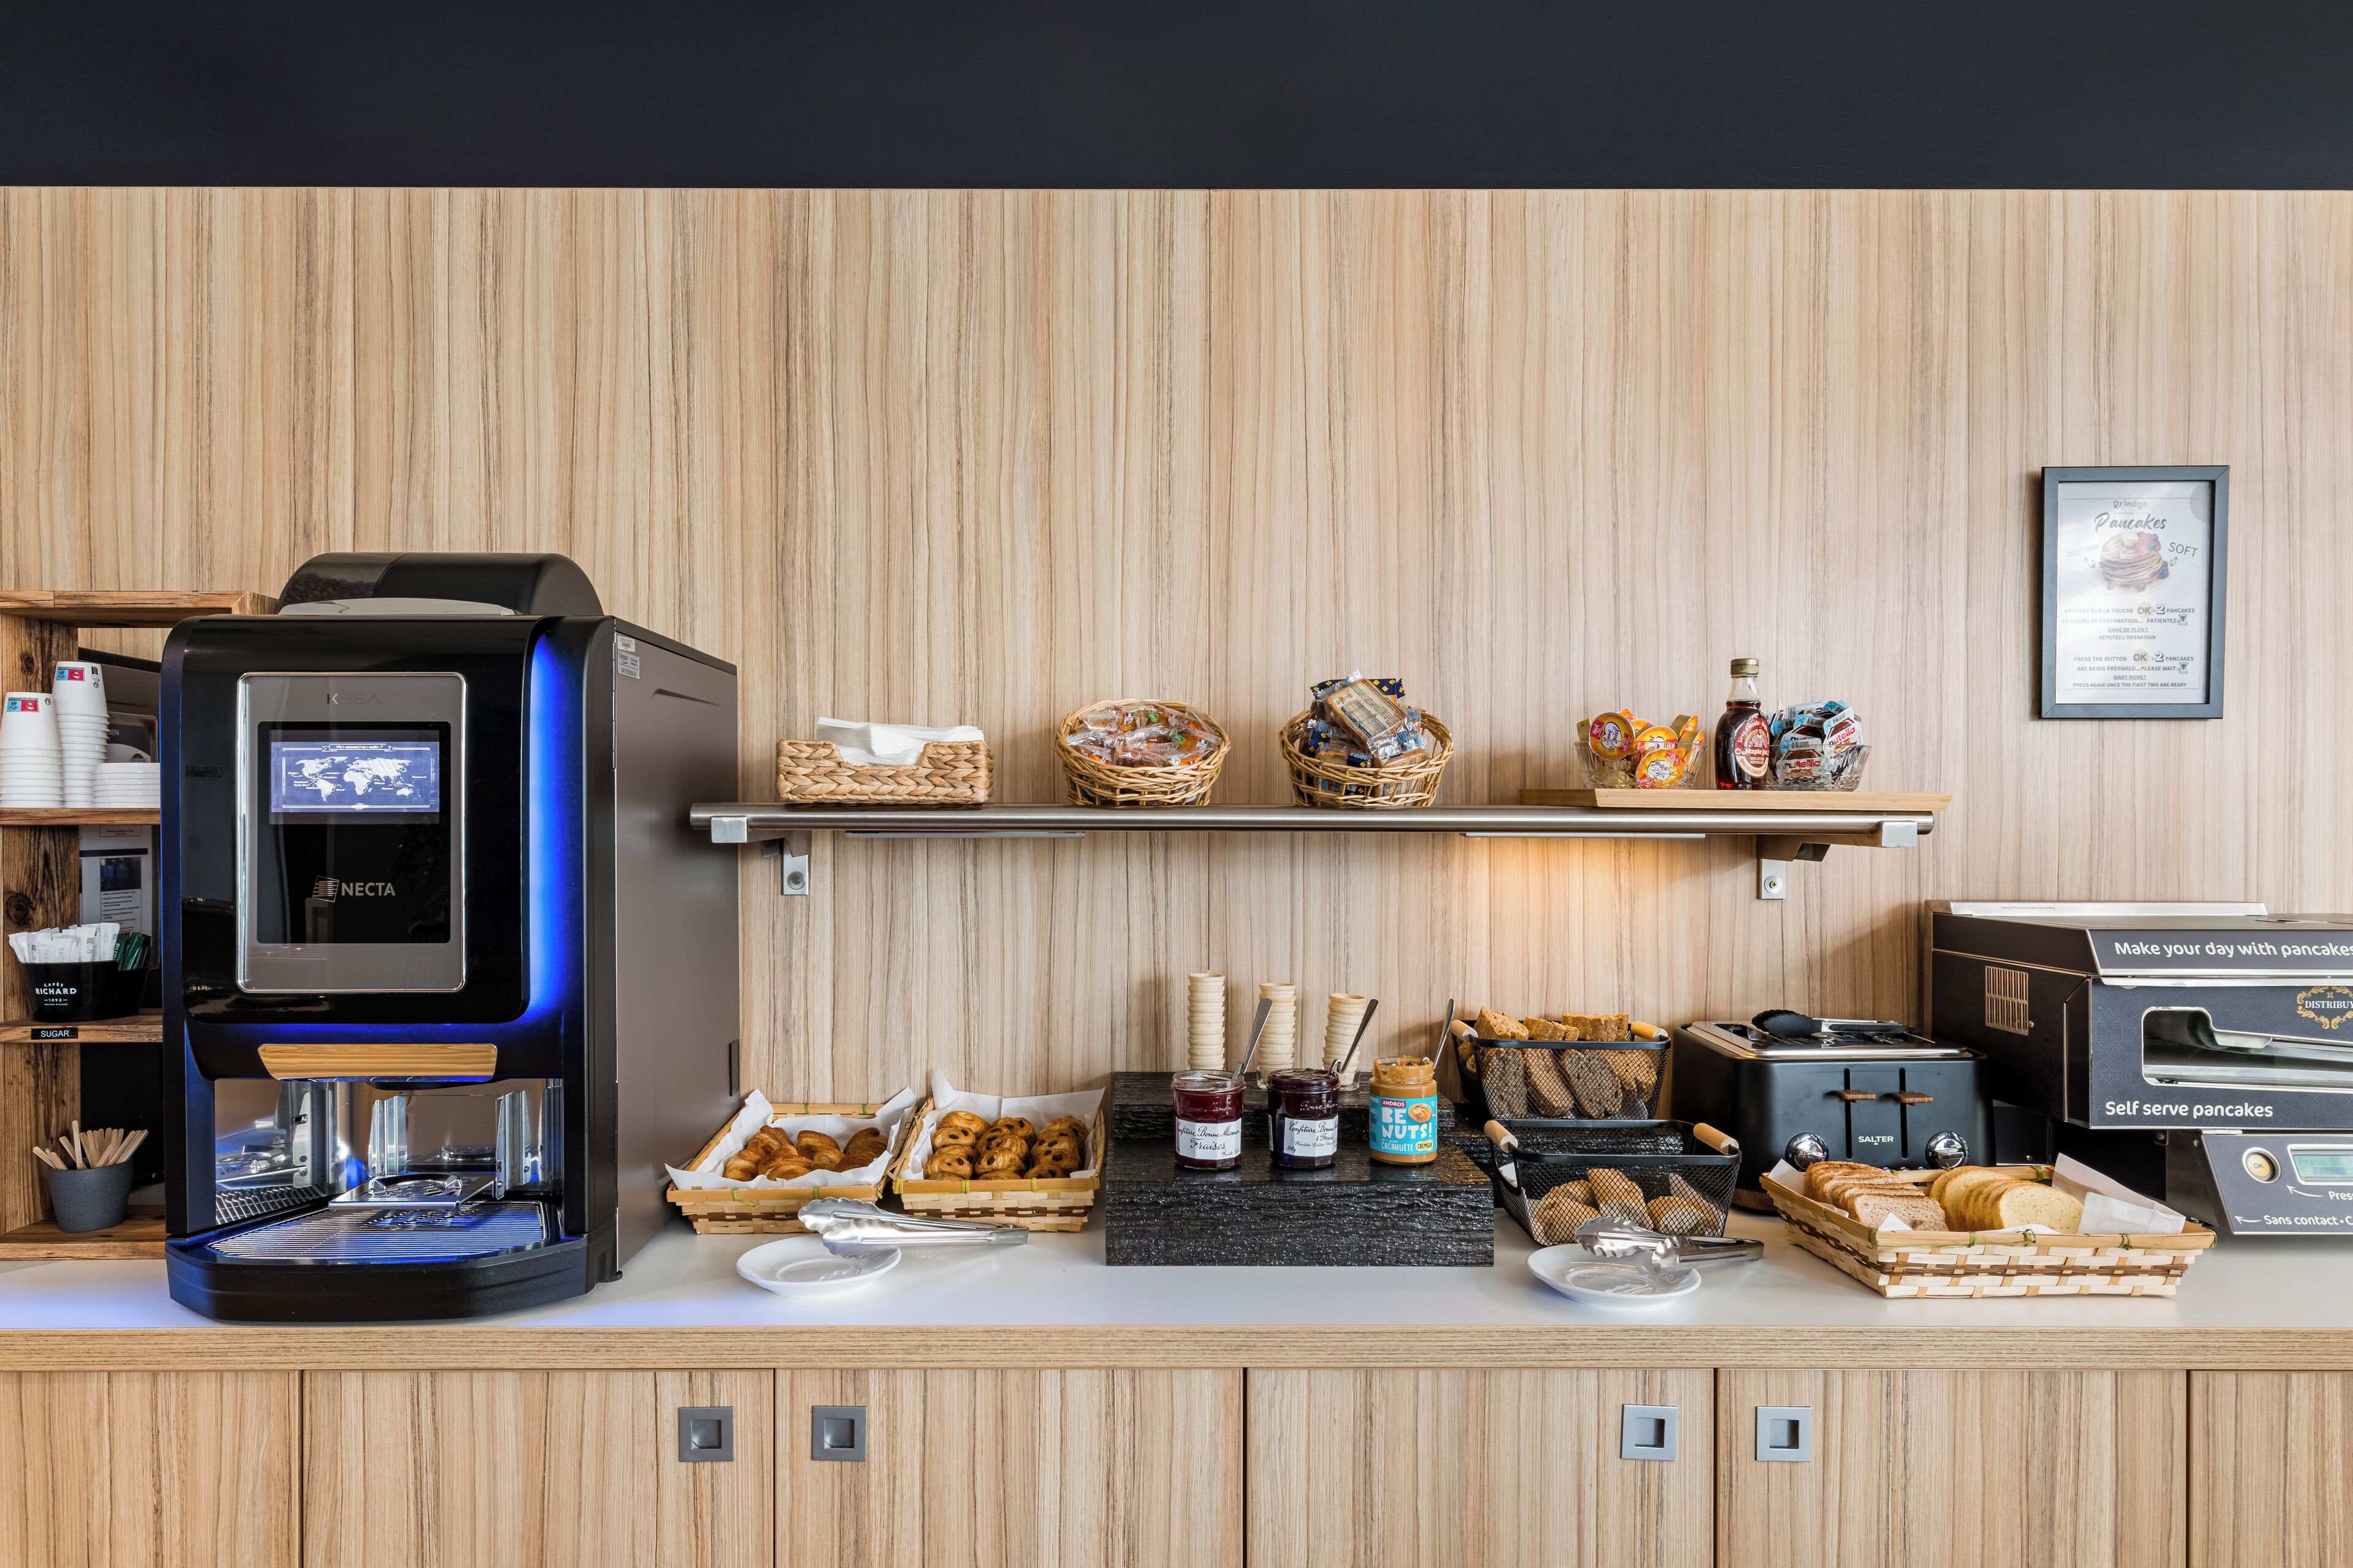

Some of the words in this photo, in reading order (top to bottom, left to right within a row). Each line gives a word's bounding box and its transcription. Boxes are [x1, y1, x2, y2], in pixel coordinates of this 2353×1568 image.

[2094, 512, 2167, 532] Pancakes
[2067, 543, 2099, 558] DELICIOUS
[2168, 542, 2199, 557] SOFT
[1828, 727, 1855, 745] nutella
[341, 882, 396, 896] NECTA
[2114, 941, 2161, 955] Make
[2162, 944, 2201, 958] your
[2205, 942, 2234, 958] day
[2237, 941, 2278, 956] with
[1382, 1107, 1406, 1124] BE
[2105, 1100, 2140, 1116] Self
[2143, 1104, 2189, 1116] serve
[2192, 1102, 2273, 1119] pancakes
[1197, 1126, 1220, 1137] Bonne
[1289, 1121, 1317, 1134] Confiture
[1382, 1122, 1432, 1138] NUTS!
[1190, 1138, 1227, 1150] Fraises
[1382, 1142, 1413, 1151] CACAHUÈTE
[2328, 1191, 2353, 1200] Pres
[2264, 1214, 2292, 1225] Sans
[2294, 1216, 2339, 1225] contact
